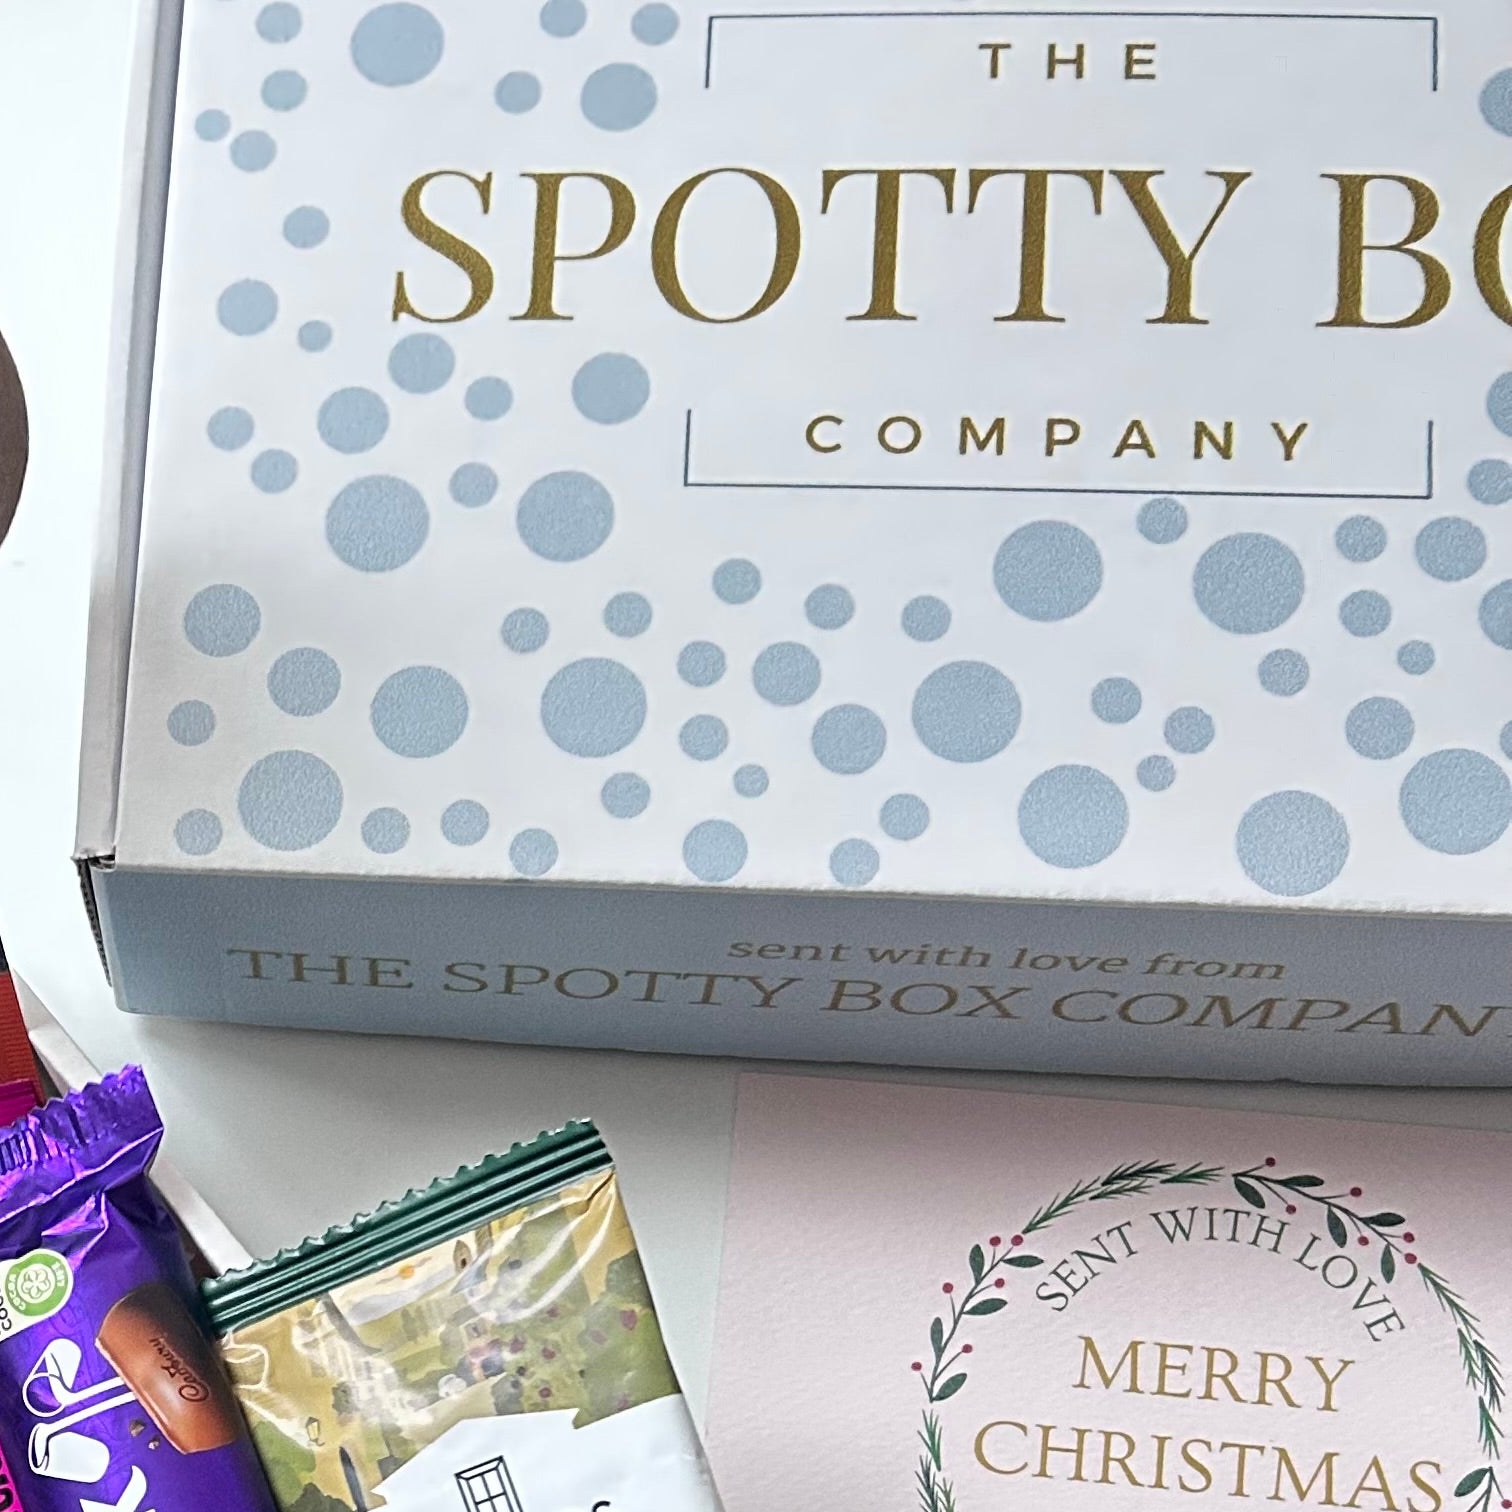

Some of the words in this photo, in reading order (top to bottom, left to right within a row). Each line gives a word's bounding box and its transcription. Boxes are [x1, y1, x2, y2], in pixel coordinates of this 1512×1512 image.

[978, 42, 1157, 81] THE
[391, 167, 1253, 328] SPOTTY
[804, 414, 1312, 464] COMPANY
[227, 948, 413, 989] THE
[442, 961, 802, 1009] SPOTTY
[821, 977, 1032, 1021] BOX
[1051, 989, 1512, 1038] COMPAN
[727, 939, 850, 961] sent
[867, 943, 990, 968] with
[1008, 947, 1130, 975] love
[1144, 951, 1286, 980] from
[1035, 1221, 1140, 1312] SENT
[1149, 1206, 1291, 1255] WITH
[1293, 1233, 1406, 1343] LOVE
[1072, 1335, 1356, 1413] MERRY
